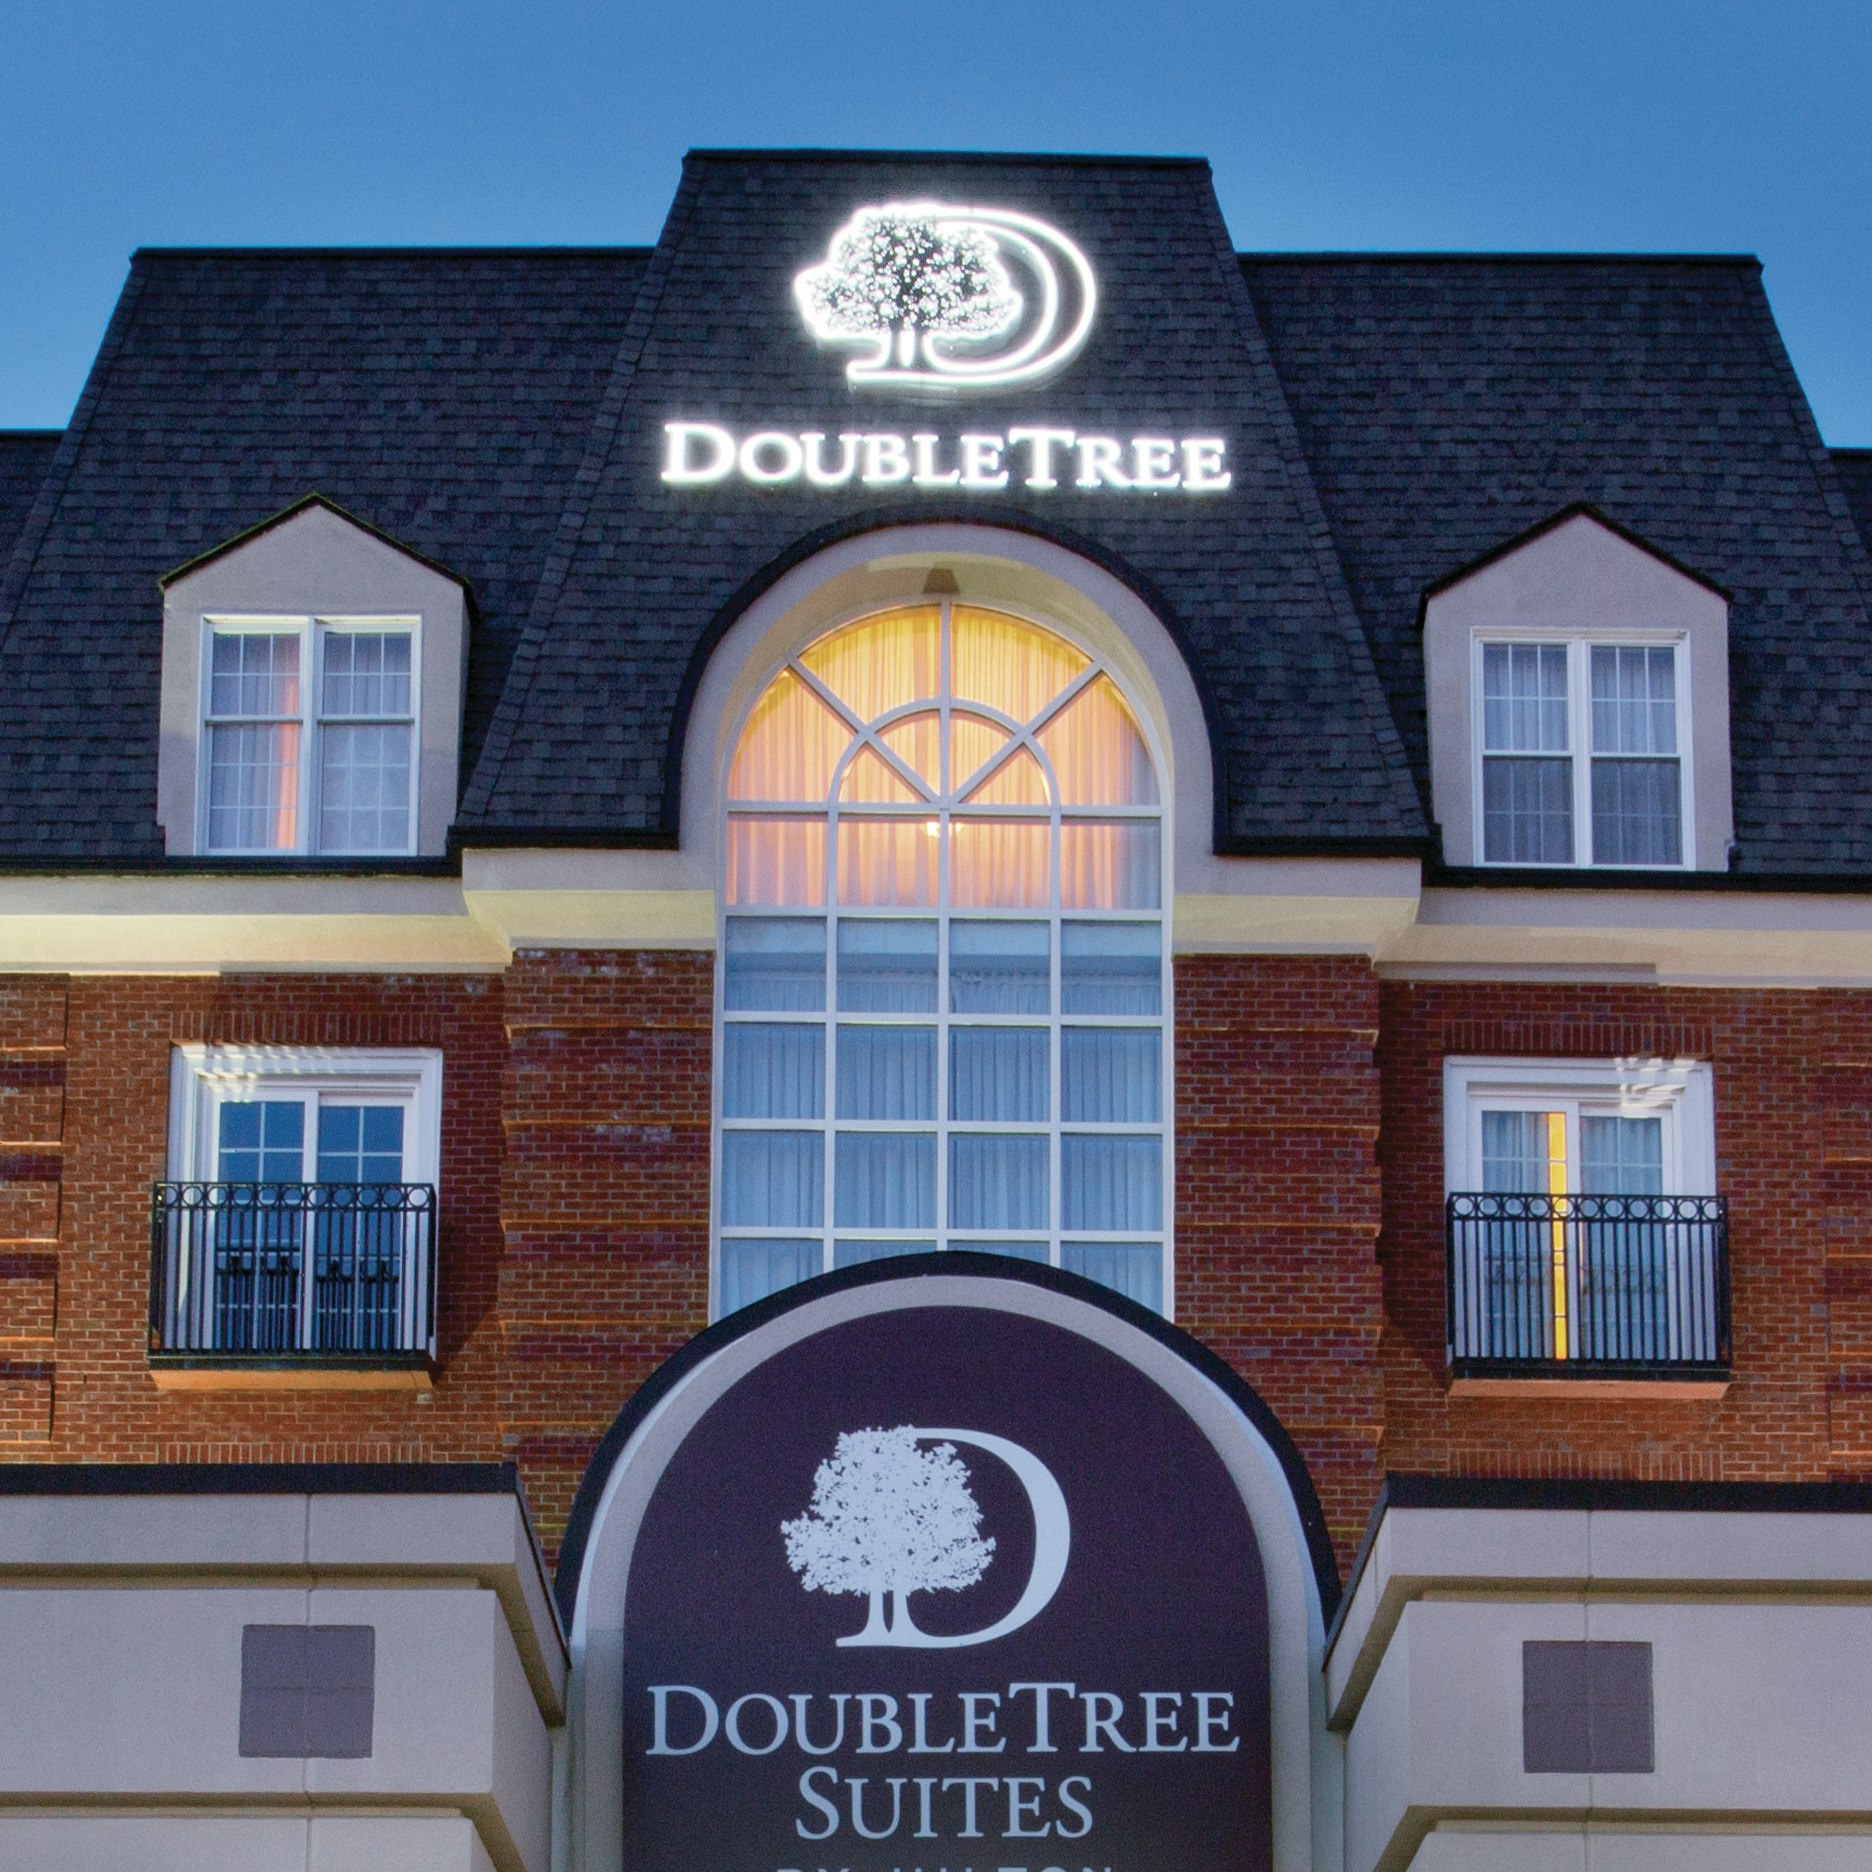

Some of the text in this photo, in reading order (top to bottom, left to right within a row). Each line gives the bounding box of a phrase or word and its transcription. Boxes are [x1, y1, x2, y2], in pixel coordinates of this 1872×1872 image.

[660, 420, 1232, 492] DOUBLETREE
[645, 1682, 1240, 1755] DOUBLETREE
[795, 1766, 1094, 1840] SUITES
